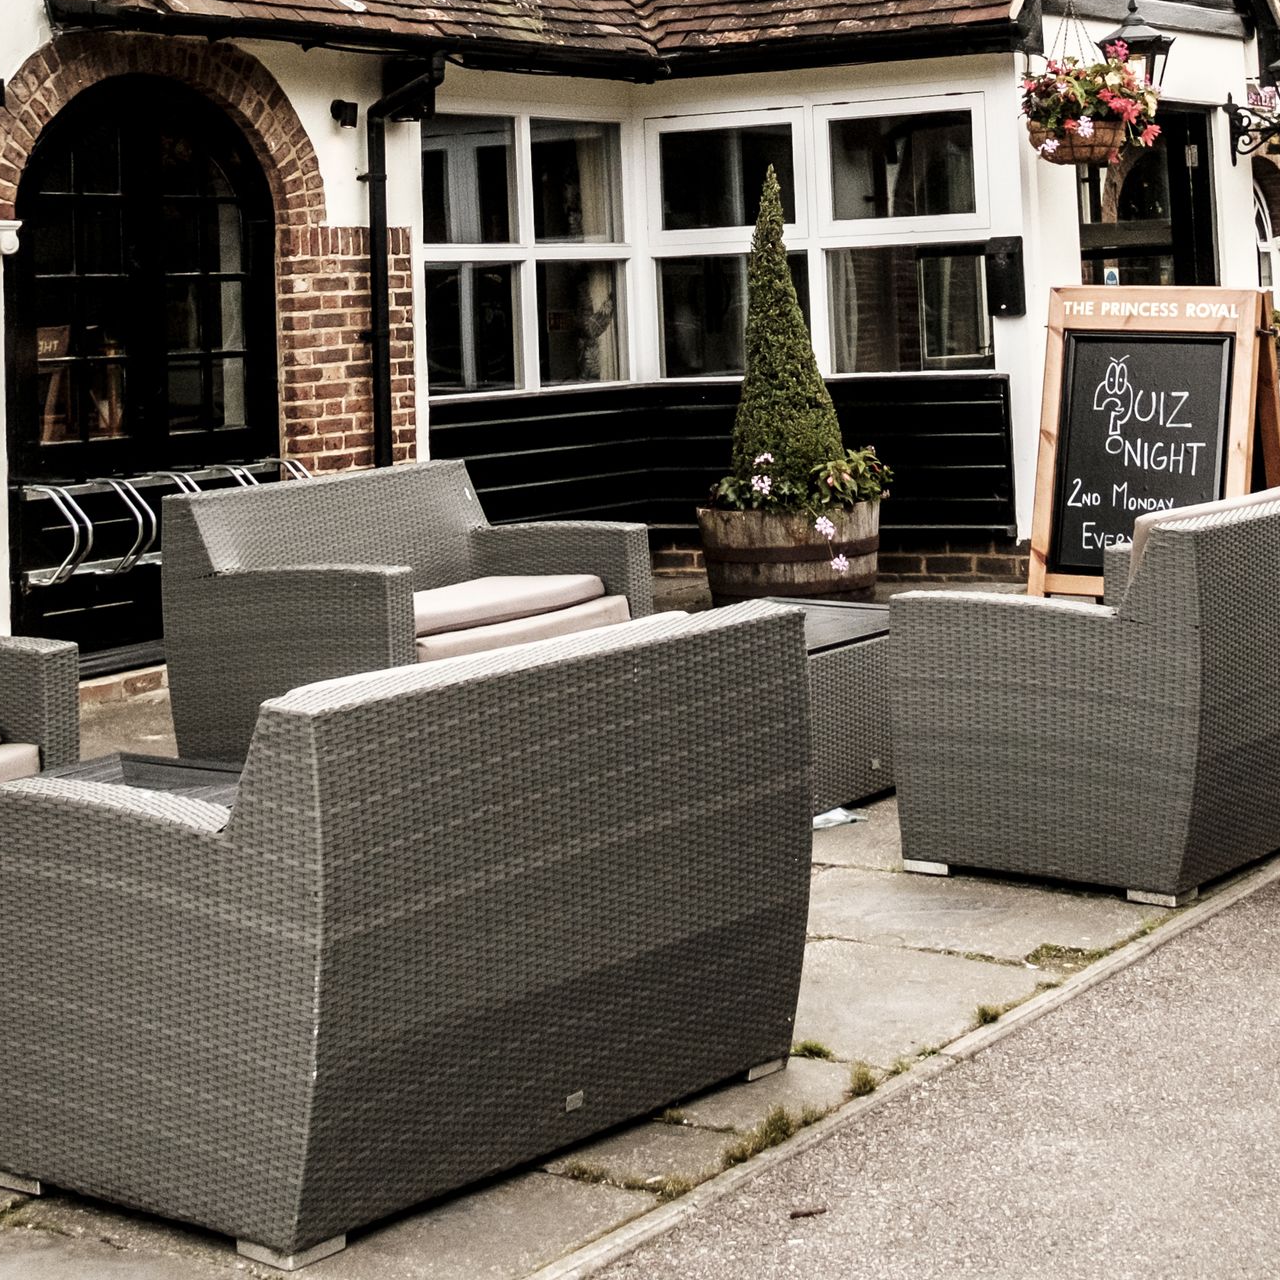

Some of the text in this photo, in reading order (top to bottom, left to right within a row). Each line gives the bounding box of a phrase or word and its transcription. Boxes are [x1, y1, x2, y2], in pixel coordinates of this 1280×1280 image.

[1064, 300, 1239, 319] THE PRINCESS ROYAL
[1124, 438, 1206, 476] NIGHT
